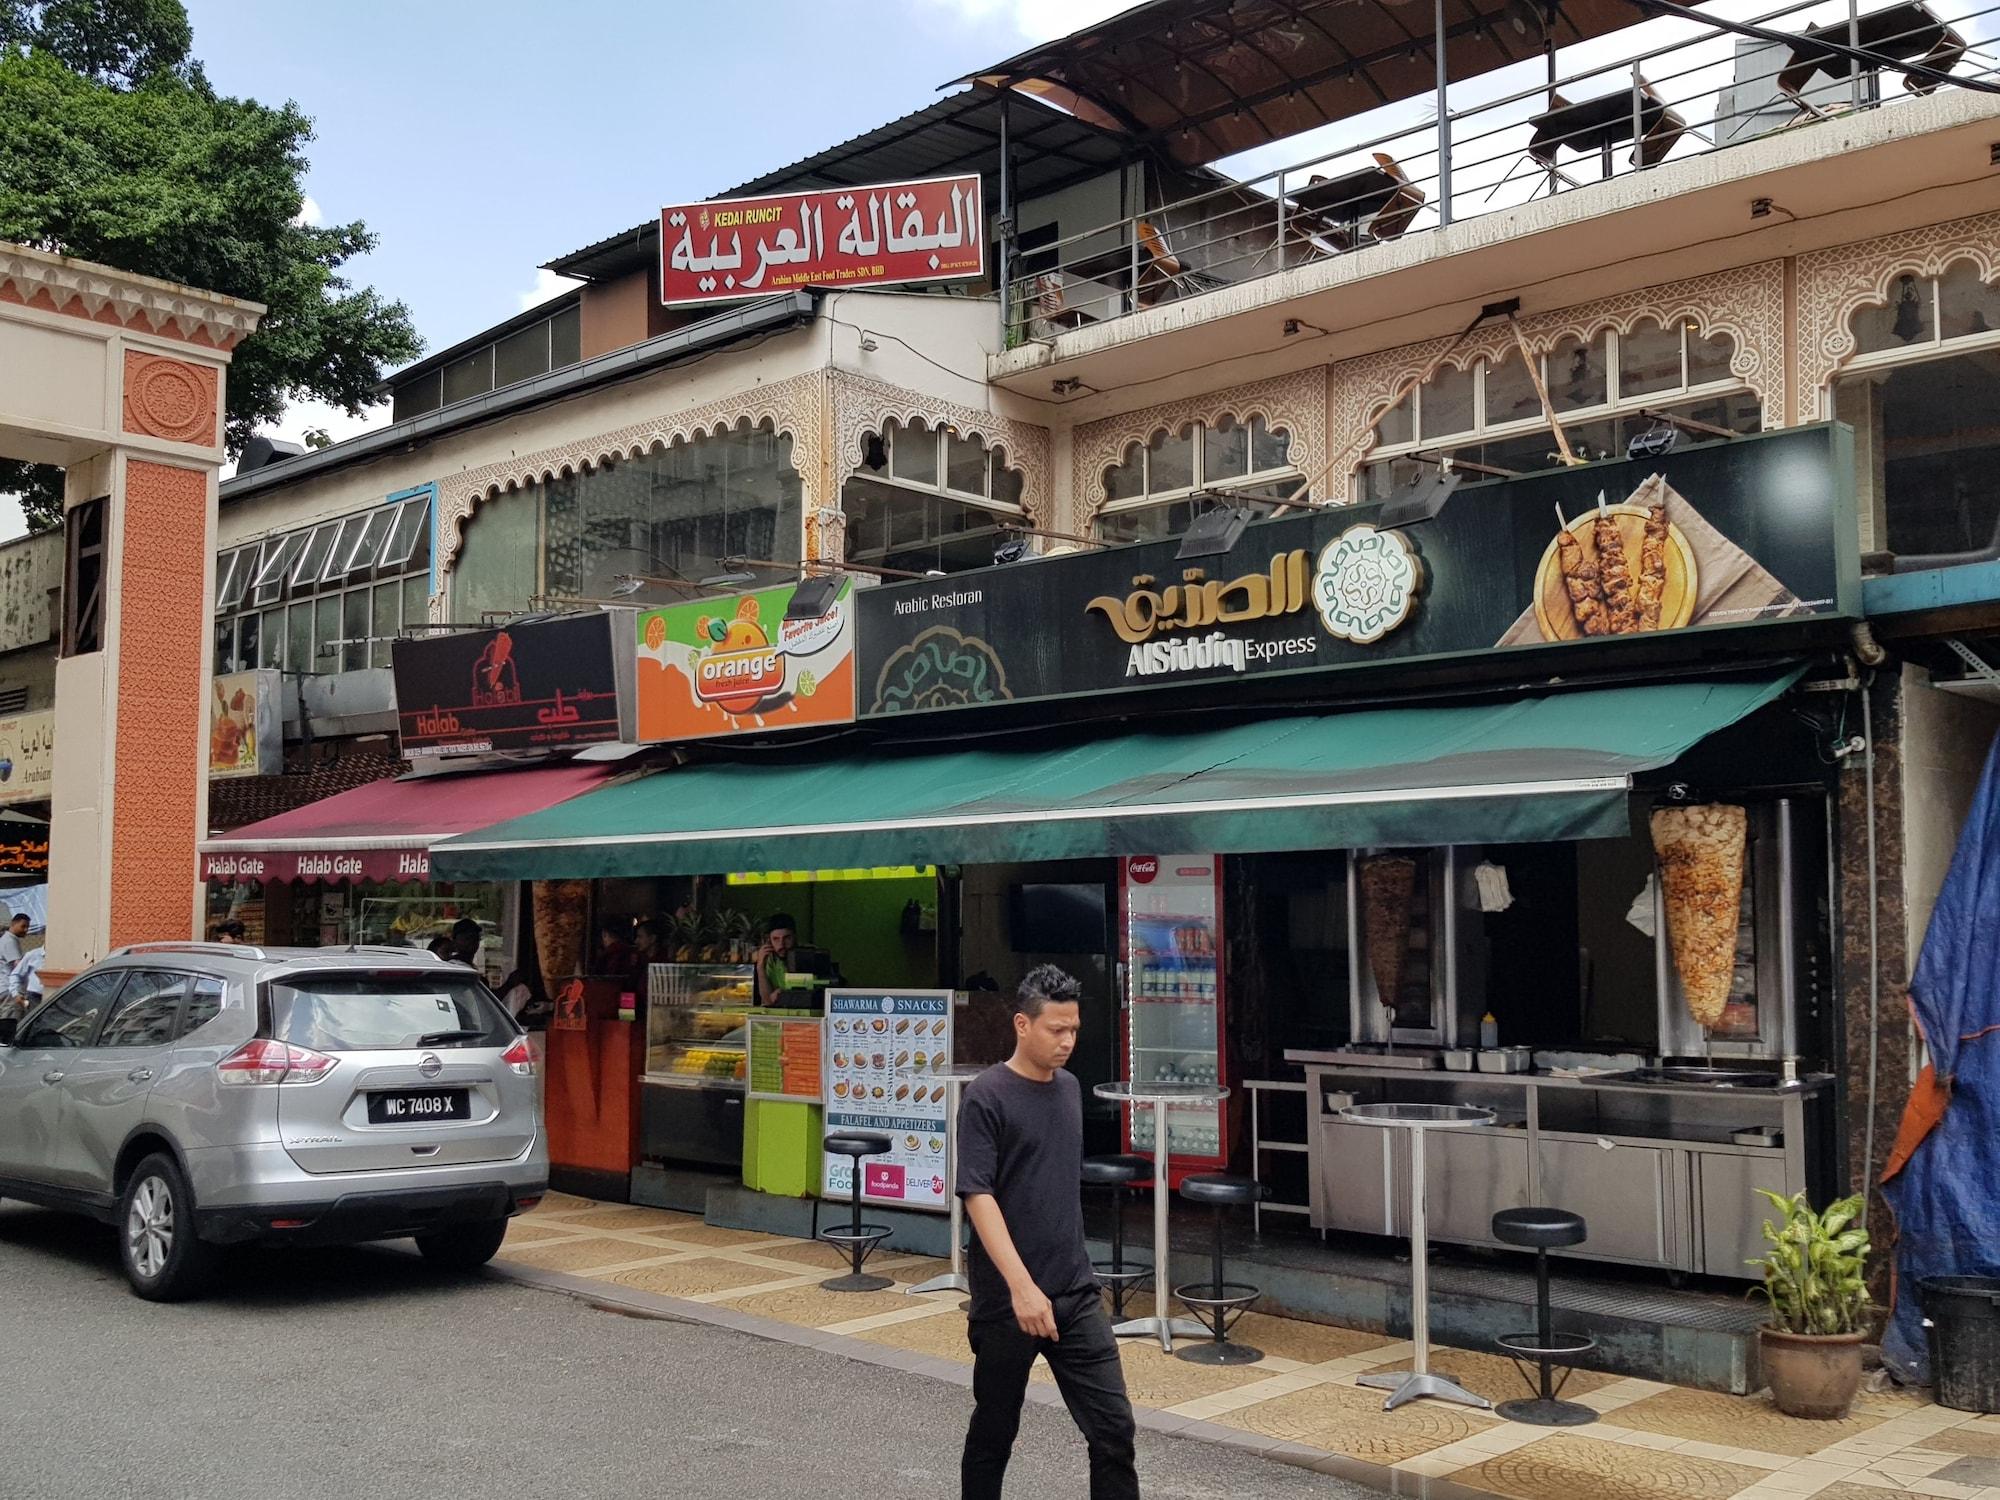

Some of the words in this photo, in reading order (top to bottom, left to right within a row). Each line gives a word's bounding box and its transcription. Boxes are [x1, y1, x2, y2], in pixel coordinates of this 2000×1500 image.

[714, 211, 743, 227] KEDAI
[745, 206, 782, 224] RUNCIT
[836, 183, 974, 270] البقالة
[669, 199, 823, 292] العربية
[772, 275, 792, 285] Arabian
[792, 272, 810, 283] Middle
[811, 270, 822, 281] East
[822, 268, 836, 280] Food
[836, 267, 856, 278] Traders
[894, 599, 928, 615] Arabic
[931, 590, 982, 609] Restoran
[784, 622, 813, 642] Favorite
[1125, 631, 1246, 676] AlSiddiq
[1245, 636, 1317, 663] Express
[703, 655, 776, 681] orange
[417, 703, 460, 735] Halab
[207, 857, 237, 875] Halab
[239, 857, 265, 874] Gate
[297, 855, 332, 874] Halab
[334, 856, 362, 874] Gate
[399, 853, 430, 873] Hala
[832, 999, 878, 1011] SHAWARMA
[897, 1000, 944, 1011] SNACKS
[386, 1098, 406, 1116] WC
[409, 1097, 443, 1115] 7408
[444, 1095, 454, 1113] X
[840, 1114, 872, 1127] FALAFEL
[873, 1116, 890, 1129] AND
[890, 1117, 936, 1131] APPETIZERS
[871, 1180, 900, 1190] foodpanda
